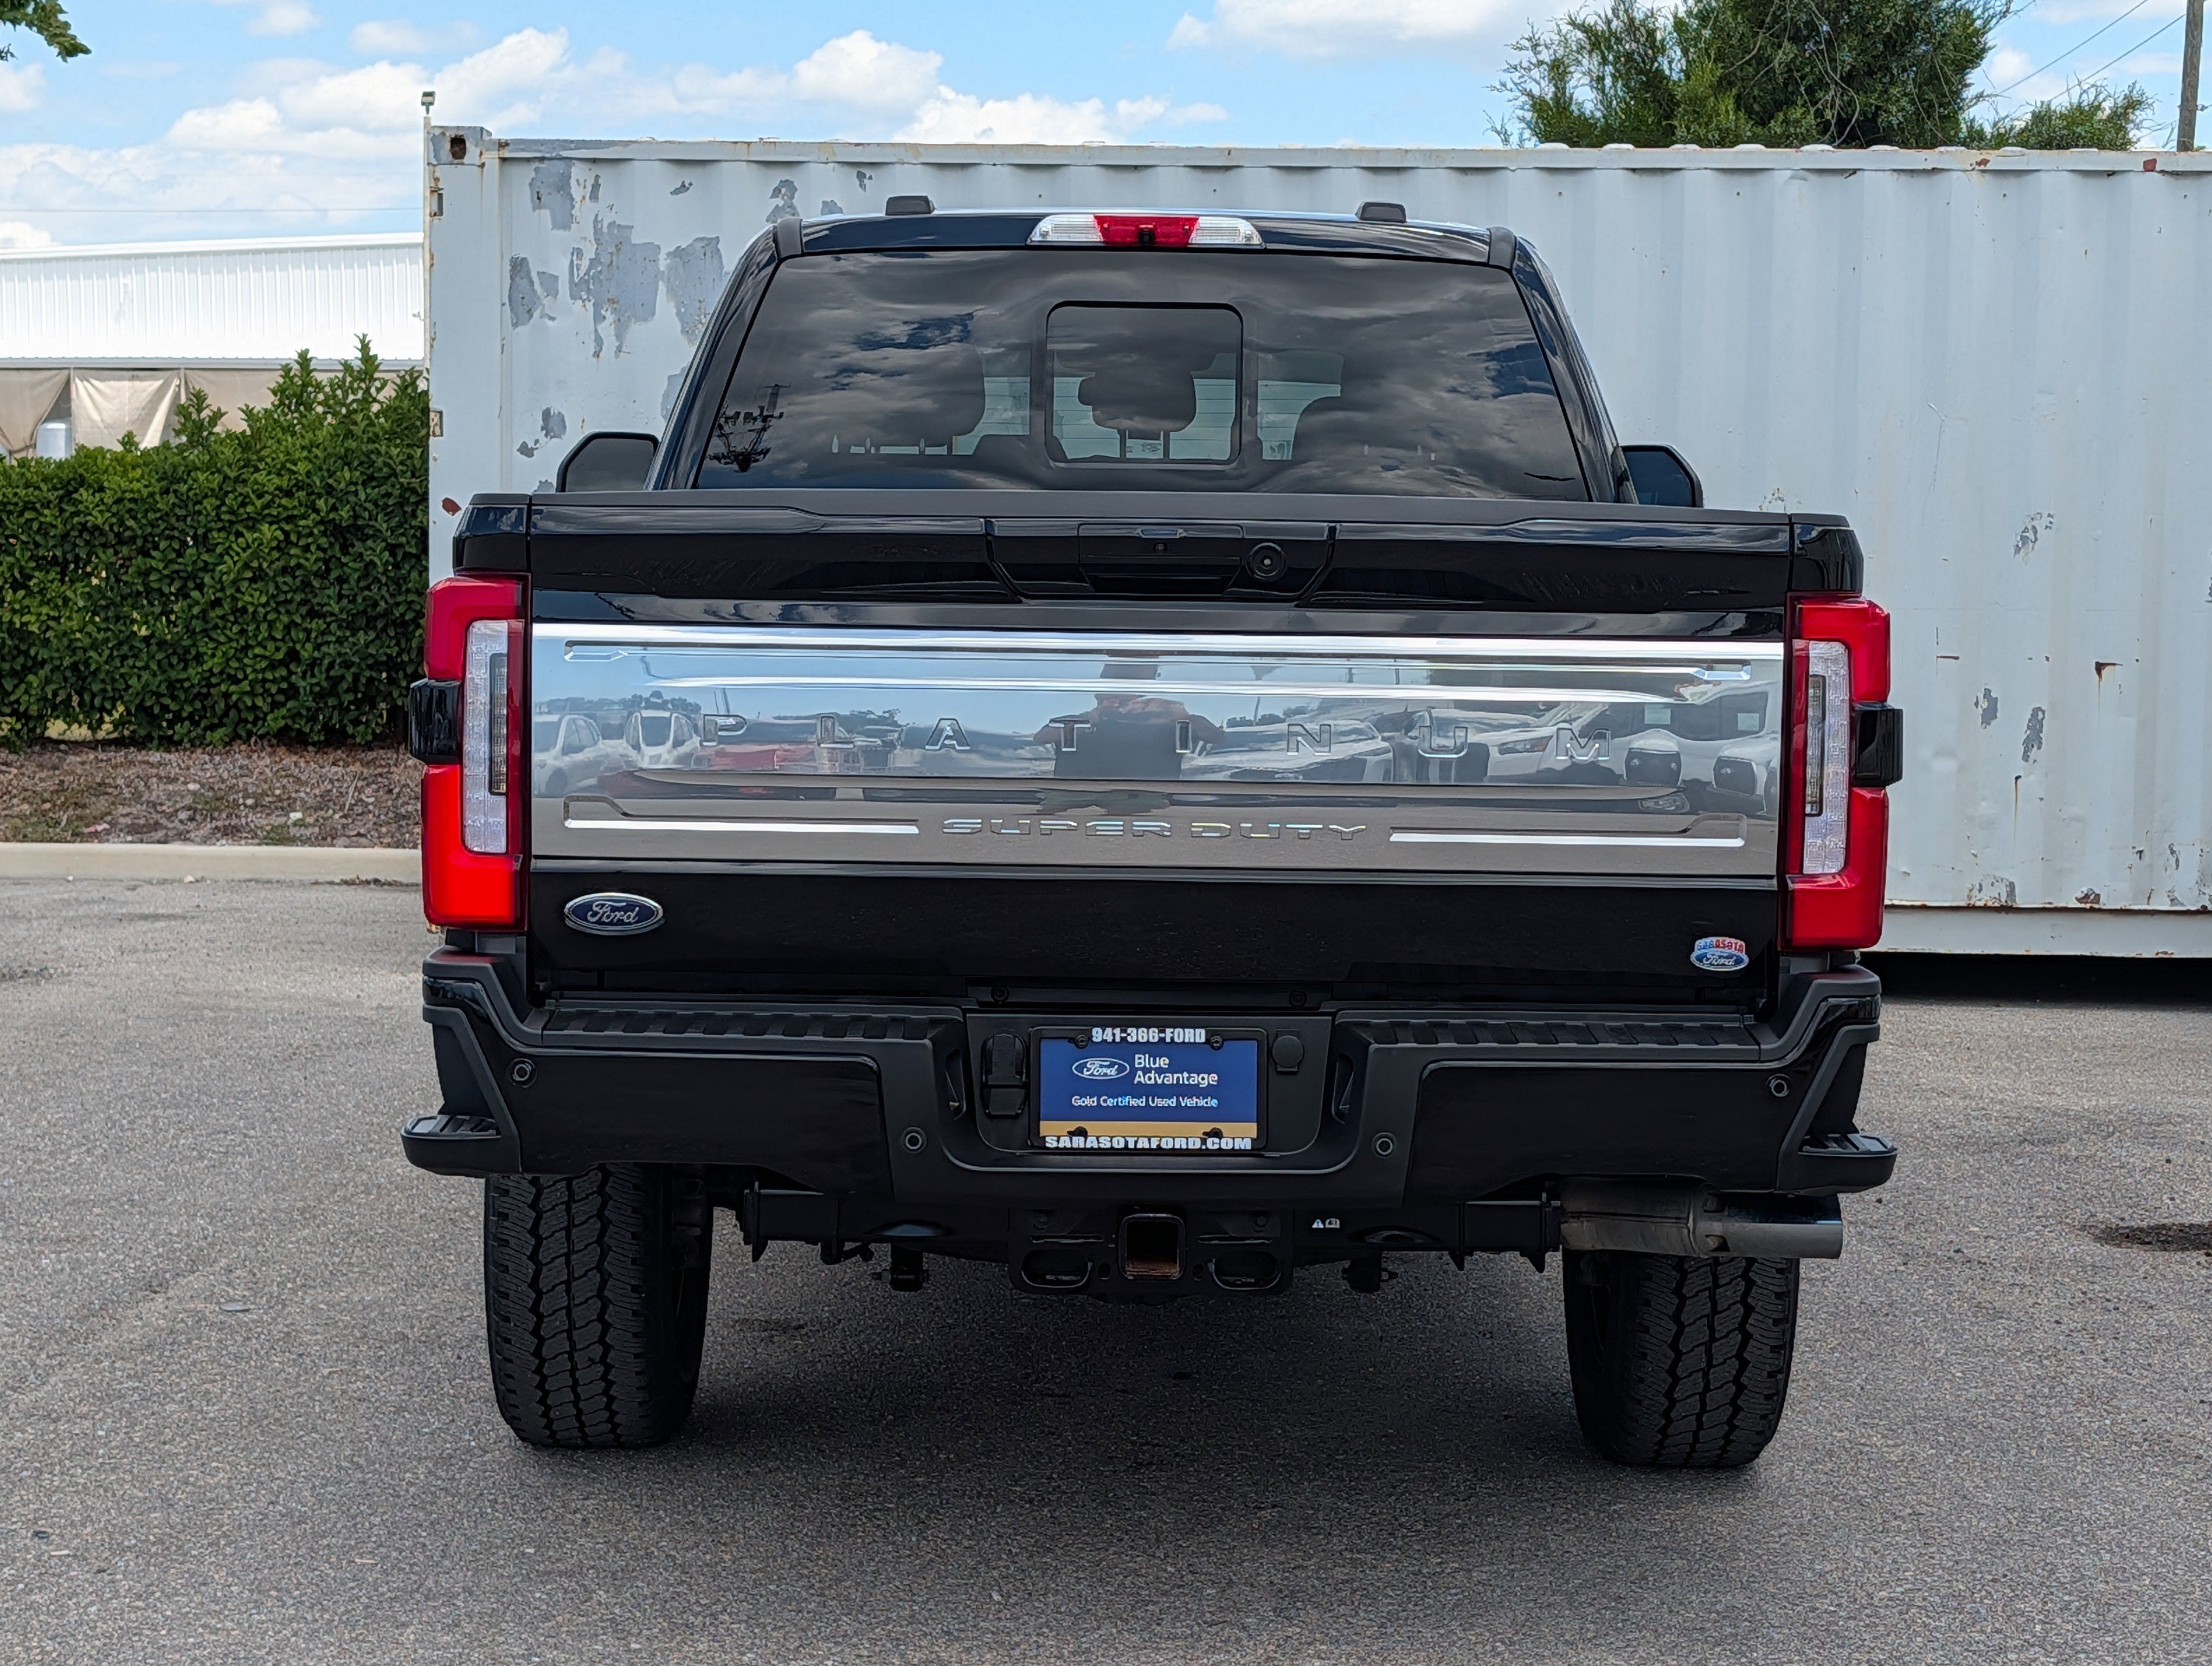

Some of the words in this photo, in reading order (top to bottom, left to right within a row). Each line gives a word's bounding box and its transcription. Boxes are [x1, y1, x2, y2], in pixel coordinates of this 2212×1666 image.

[701, 713, 1611, 760] PLATINUM
[942, 818, 1172, 838] SUPER
[1191, 823, 1367, 841] DUTY
[587, 900, 639, 923] Ford
[1703, 952, 1737, 965] Ford
[1091, 1027, 1206, 1043] 941-366-FORD
[1083, 1060, 1118, 1077] Ford
[1134, 1054, 1169, 1068] Blue
[1134, 1071, 1218, 1087] Advantage
[1071, 1095, 1097, 1106] Gold
[1100, 1095, 1146, 1107] Certified
[1148, 1096, 1176, 1107] Used
[1179, 1096, 1219, 1107] Vehicle
[1045, 1136, 1252, 1150] SARASOTAFORD.COM
